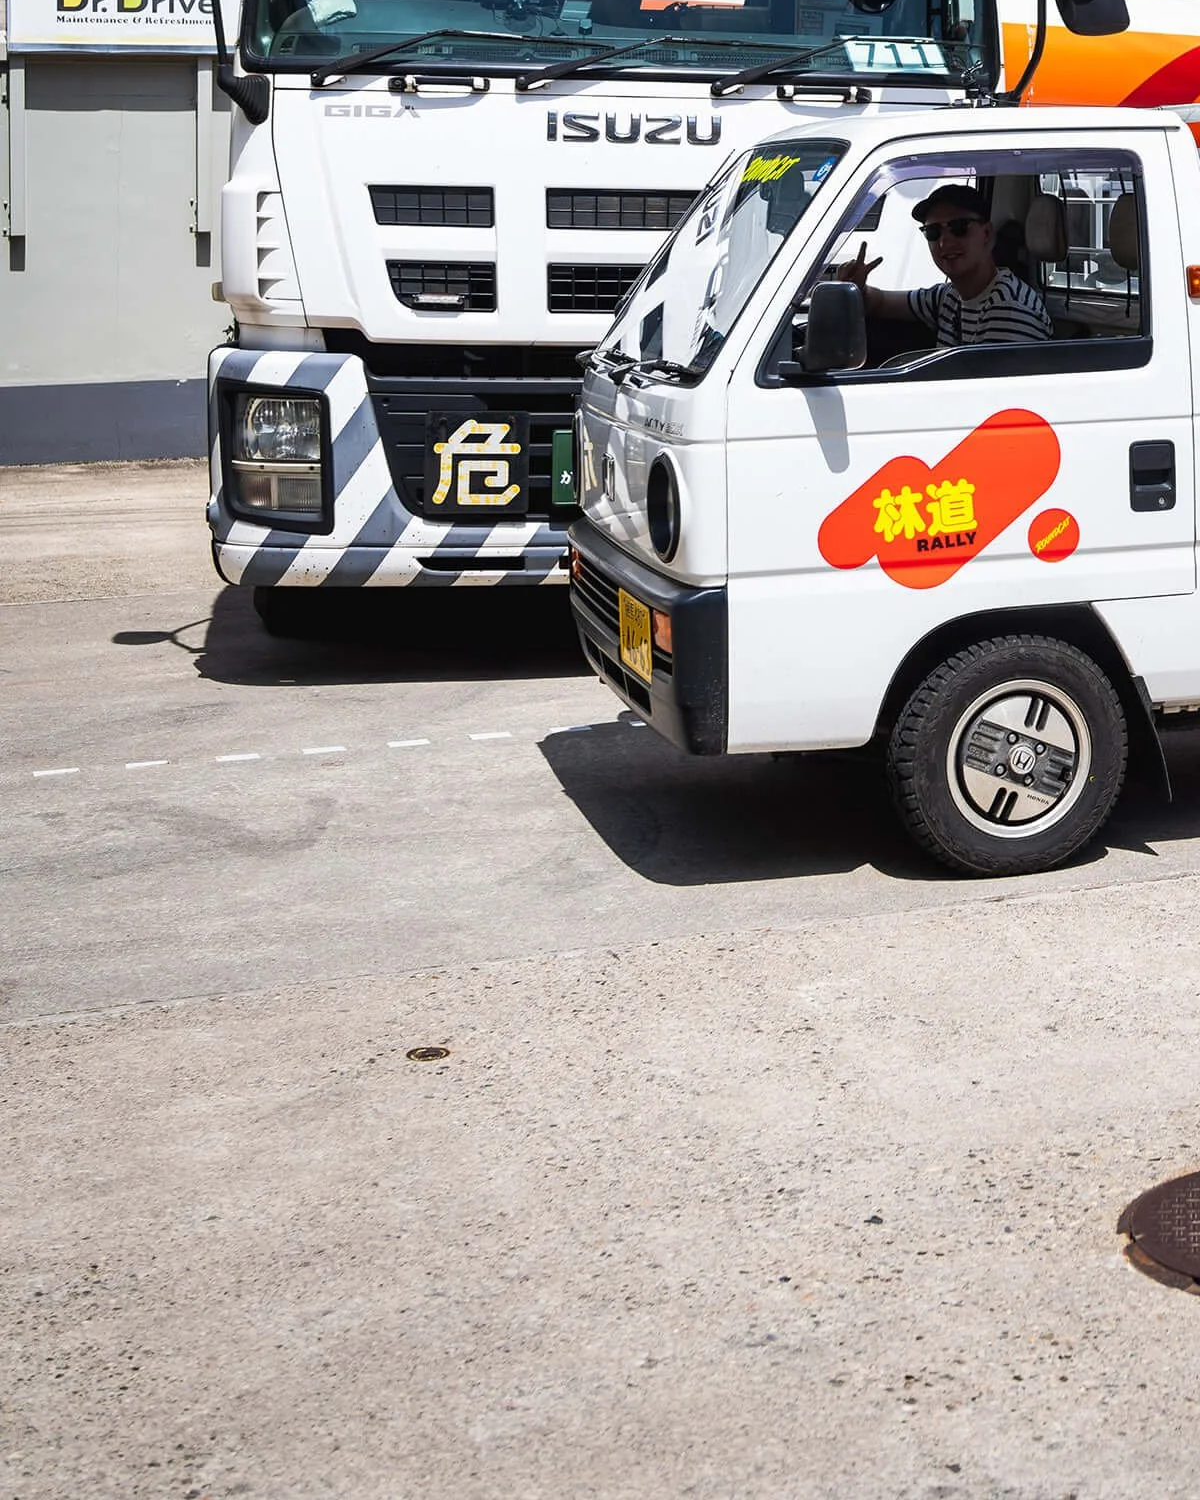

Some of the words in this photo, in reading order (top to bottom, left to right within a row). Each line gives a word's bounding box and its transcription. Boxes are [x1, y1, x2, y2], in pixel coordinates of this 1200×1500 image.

[57, 15, 129, 24] Maintenance
[145, 17, 215, 26] Refreshmen
[547, 110, 722, 146] ISUZU
[433, 419, 521, 505] 危
[873, 478, 978, 543] 林道
[917, 531, 977, 553] RALLY
